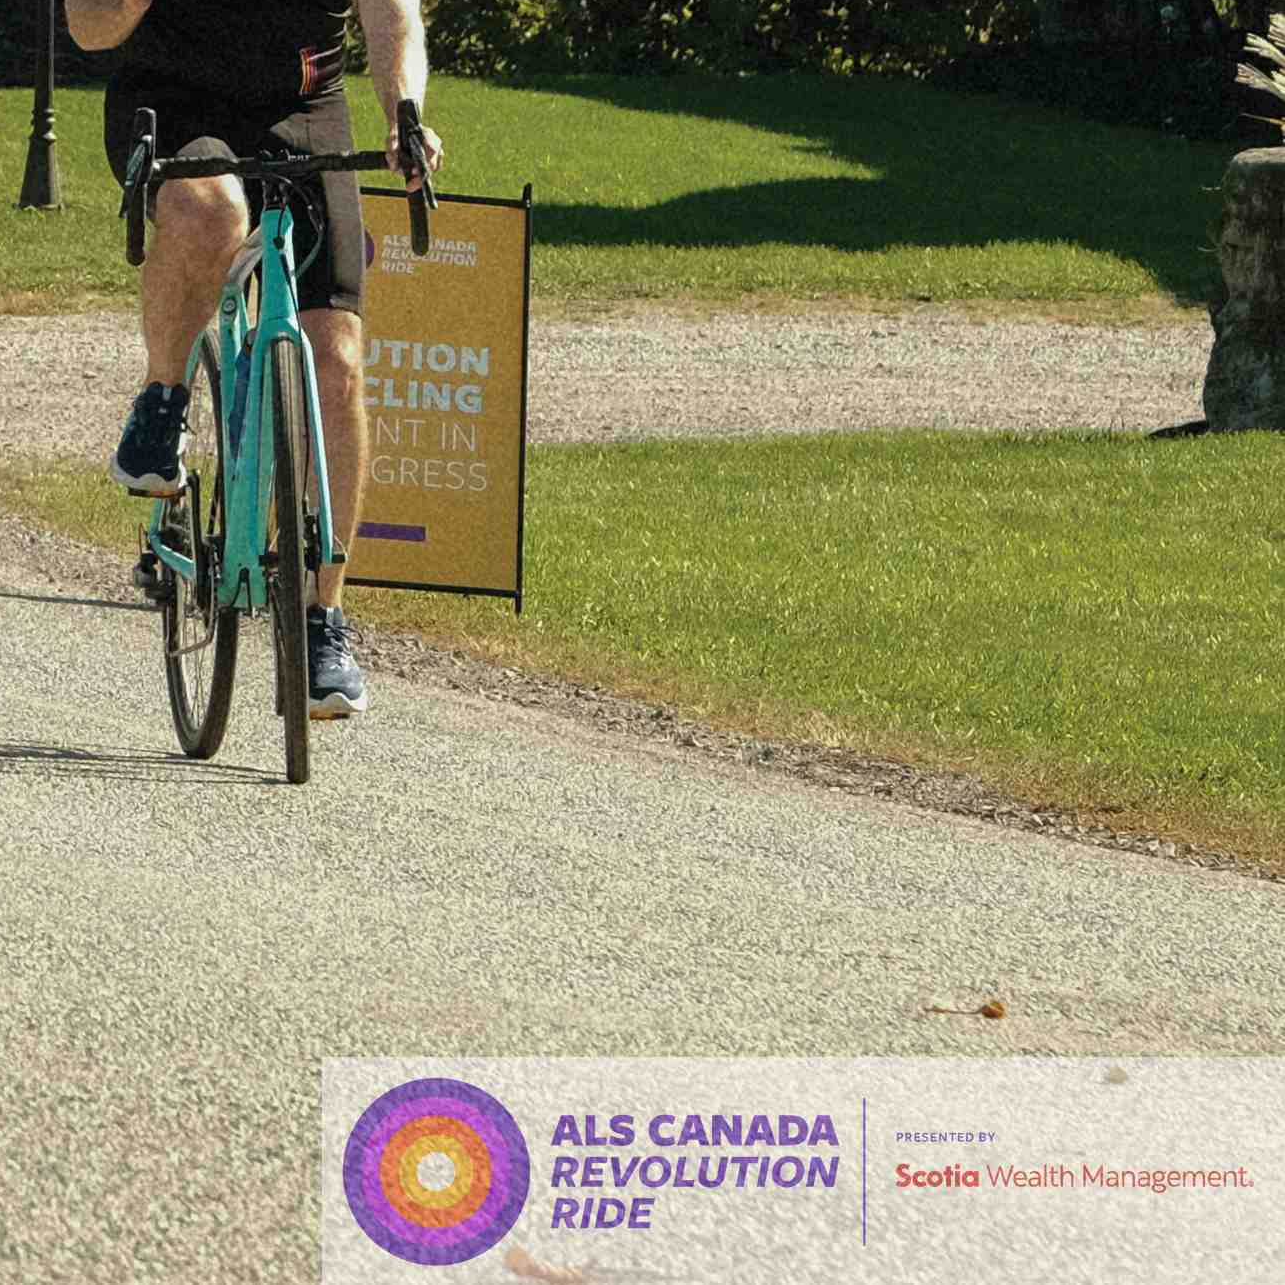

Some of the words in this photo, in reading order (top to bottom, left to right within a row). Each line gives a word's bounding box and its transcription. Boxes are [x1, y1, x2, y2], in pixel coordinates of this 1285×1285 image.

[381, 260, 415, 274] RIDE
[363, 338, 490, 377] UTION
[362, 376, 483, 414] CLING
[441, 421, 476, 452] IN
[371, 455, 487, 492] GRESS
